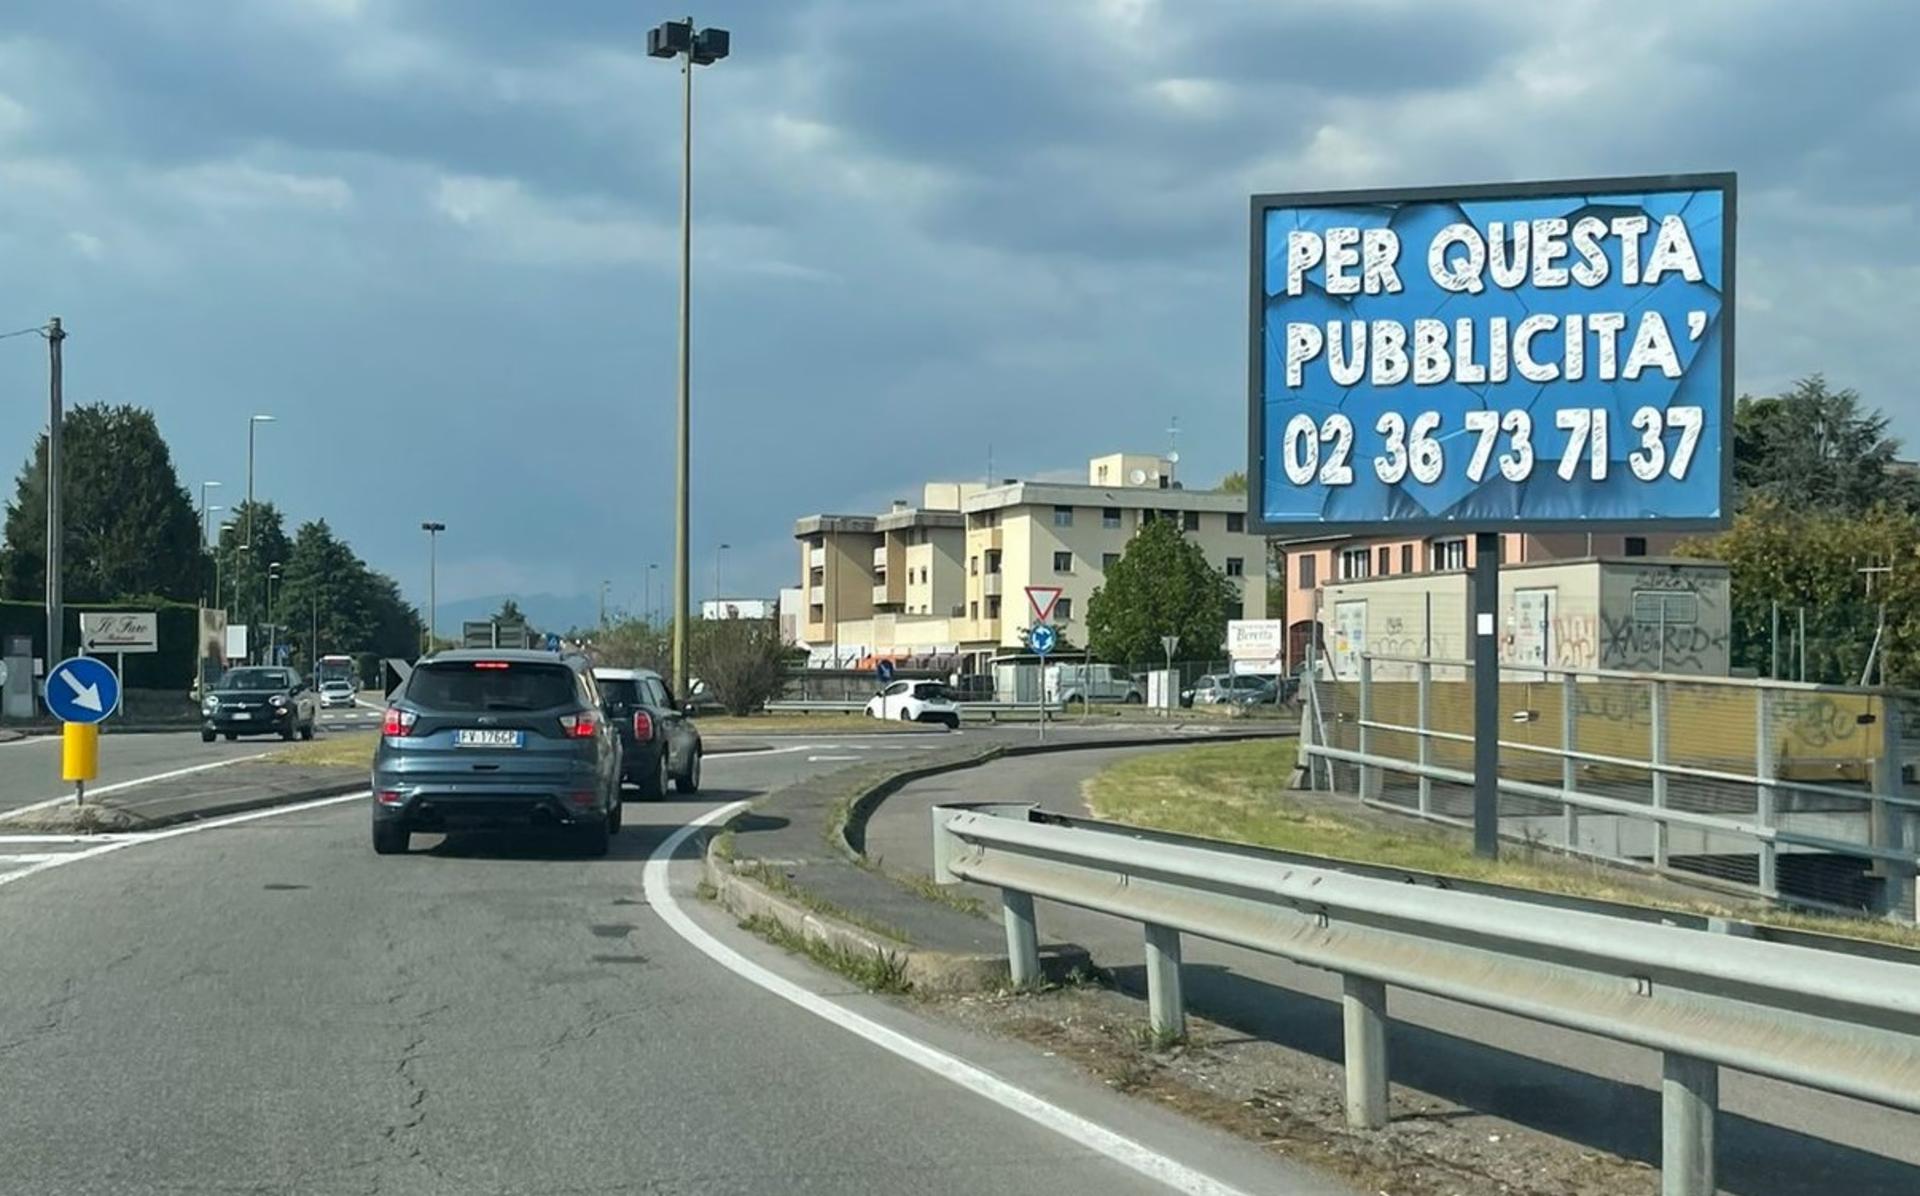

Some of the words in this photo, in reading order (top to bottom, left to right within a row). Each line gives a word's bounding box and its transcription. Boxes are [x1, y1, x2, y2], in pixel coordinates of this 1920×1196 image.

[1287, 227, 1402, 296] PER
[1427, 215, 1702, 293] QUESTA
[1282, 413, 1354, 486] 02
[1373, 410, 1444, 484] 36
[1464, 409, 1534, 483] 73
[1556, 407, 1608, 481] 71
[1628, 405, 1704, 482] 37
